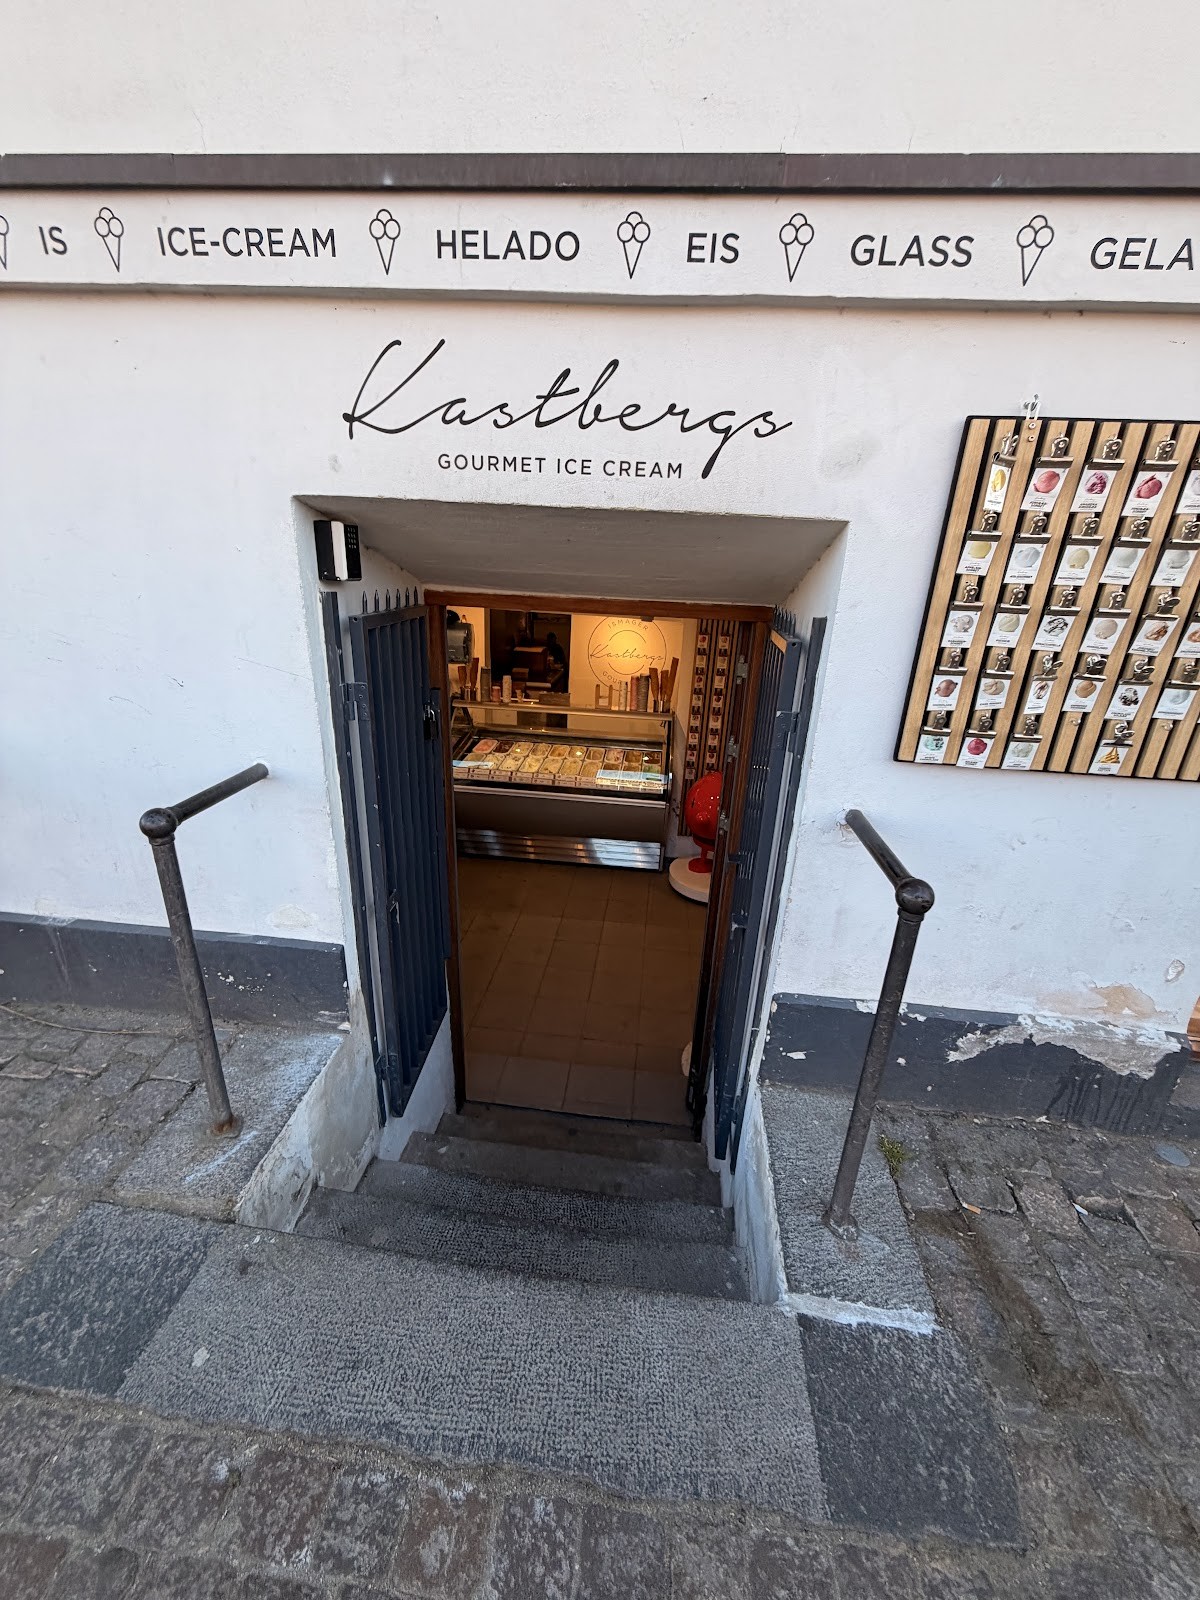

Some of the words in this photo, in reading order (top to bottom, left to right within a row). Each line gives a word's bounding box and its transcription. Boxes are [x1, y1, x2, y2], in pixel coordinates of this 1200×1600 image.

[38, 226, 68, 255] IS
[157, 226, 337, 258] ICE-CREAM
[436, 229, 580, 262] HELADO
[686, 232, 740, 264] EIS
[850, 234, 975, 268] GLASS
[1090, 237, 1194, 271] GELA
[342, 338, 793, 480] Kastbergs
[438, 453, 547, 475] GOURMET
[557, 458, 592, 476] ICE
[602, 460, 683, 479] CREAM
[589, 643, 665, 667] Kastbergs
